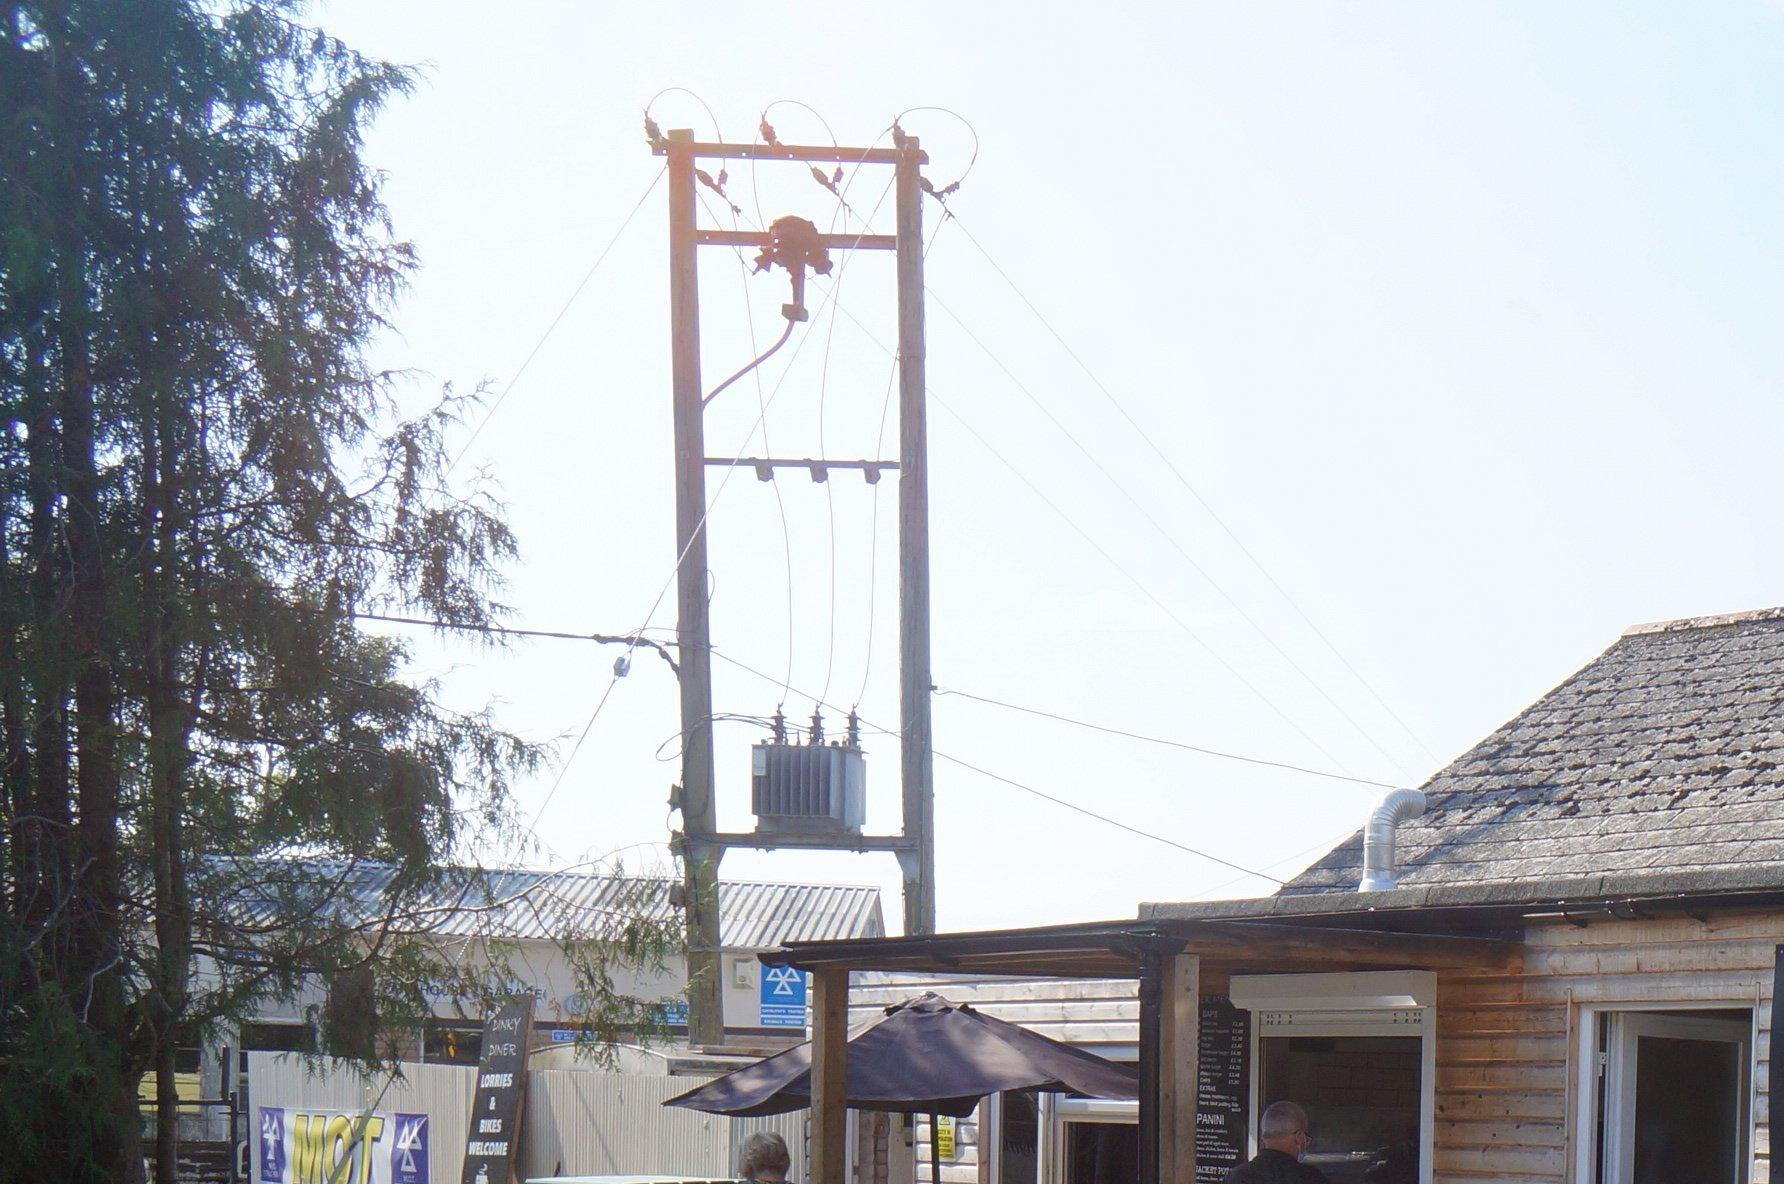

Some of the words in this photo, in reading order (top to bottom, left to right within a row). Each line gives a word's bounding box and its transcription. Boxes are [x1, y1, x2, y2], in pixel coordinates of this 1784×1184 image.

[492, 1017, 522, 1036] DINKY
[489, 1043, 517, 1057] DINER
[480, 1073, 514, 1089] LORRIES
[489, 1096, 496, 1111] &
[479, 1118, 502, 1133] BIKES
[468, 1142, 509, 1156] WELCOME
